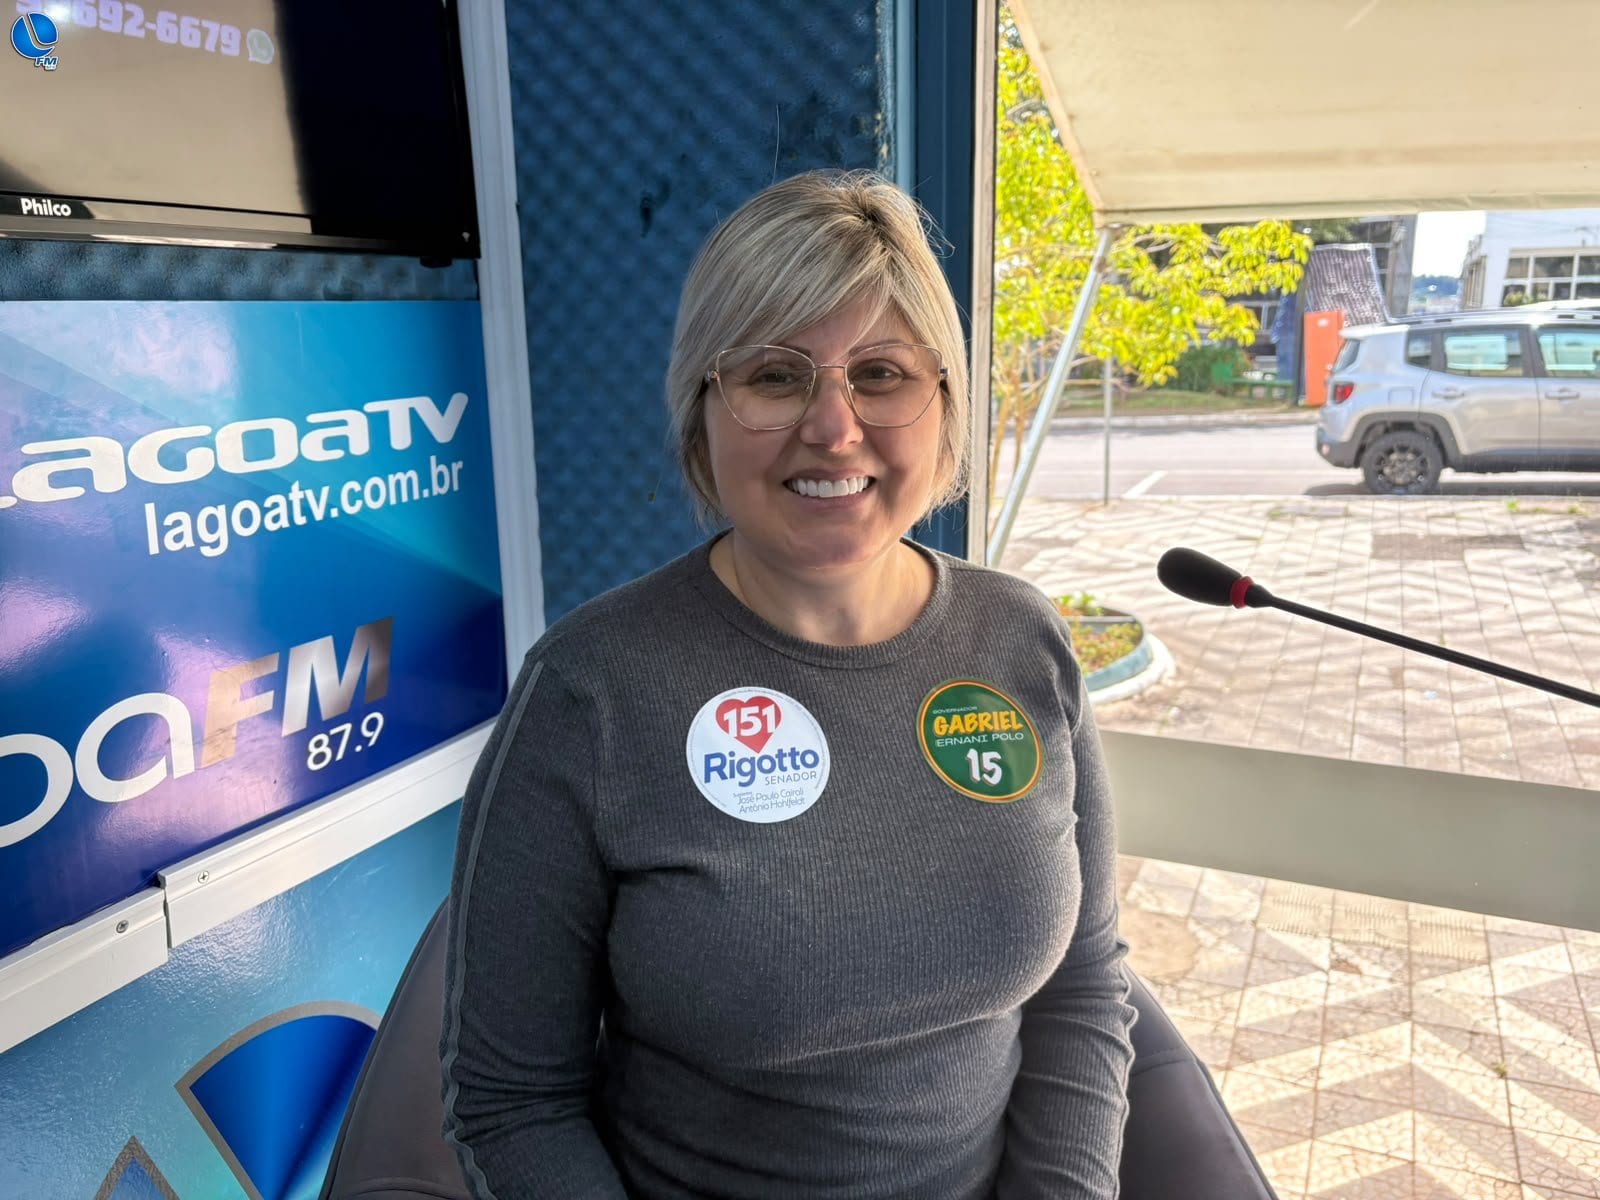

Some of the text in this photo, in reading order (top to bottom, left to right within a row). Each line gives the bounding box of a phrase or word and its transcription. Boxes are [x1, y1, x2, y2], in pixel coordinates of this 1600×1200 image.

[16, 0, 242, 57] 692-6679
[20, 198, 72, 218] Philco
[144, 455, 464, 558] lagoatv.com.br
[723, 704, 777, 738] 151
[933, 710, 1024, 737] GABRIEL
[306, 711, 386, 772] 87.9
[936, 732, 1025, 747] ERNANI POLO
[703, 747, 820, 788] Rigotto
[764, 771, 818, 785] SENADOR
[966, 748, 1003, 786] 15
[756, 791, 779, 801] Paulo
